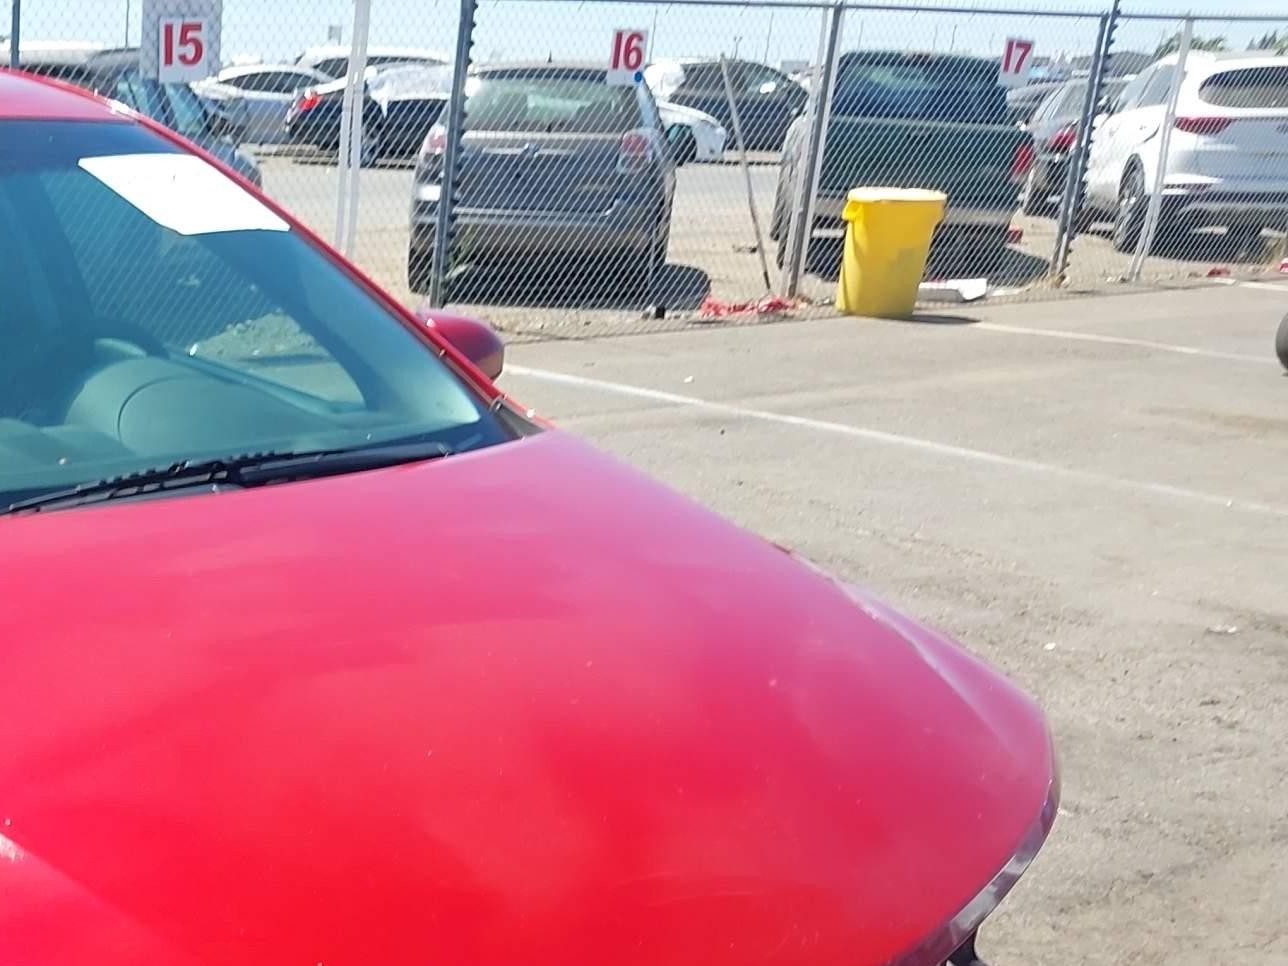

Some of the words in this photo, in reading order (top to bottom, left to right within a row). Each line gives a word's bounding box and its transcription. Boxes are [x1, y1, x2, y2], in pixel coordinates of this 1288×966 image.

[163, 22, 203, 66] 15
[612, 31, 643, 70] 16
[1003, 40, 1032, 74] 17
